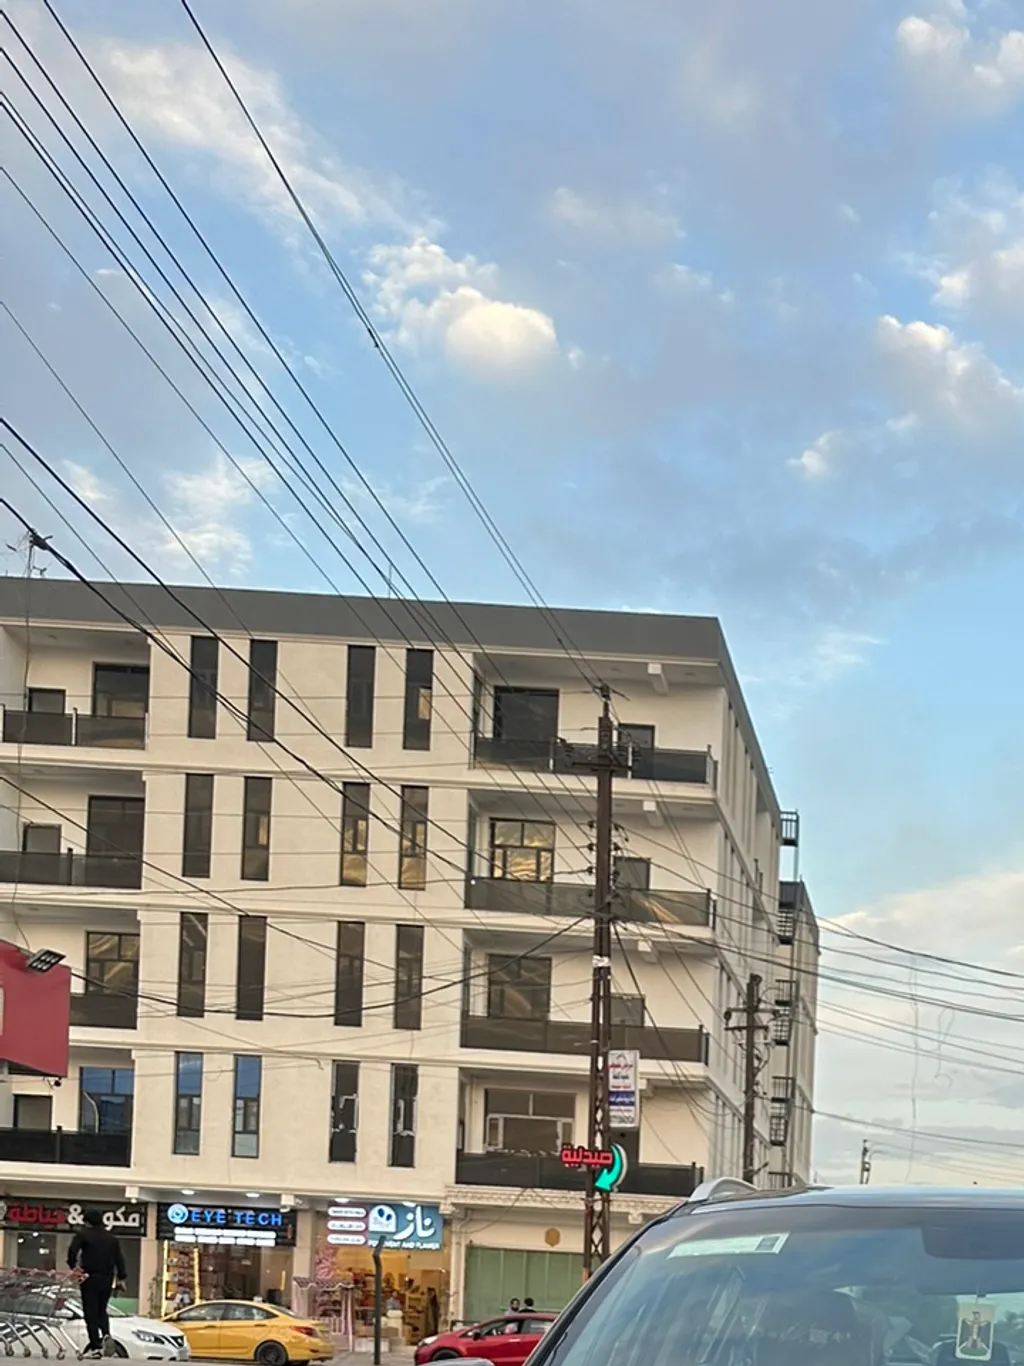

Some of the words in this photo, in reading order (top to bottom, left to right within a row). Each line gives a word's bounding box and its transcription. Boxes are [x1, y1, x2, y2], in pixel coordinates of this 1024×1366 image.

[561, 1145, 613, 1169] صيدلية
[67, 1203, 85, 1225] &
[97, 1205, 141, 1231] مكو
[190, 1208, 226, 1224] EYE
[234, 1210, 283, 1226] TECH
[393, 1205, 436, 1240] ناز
